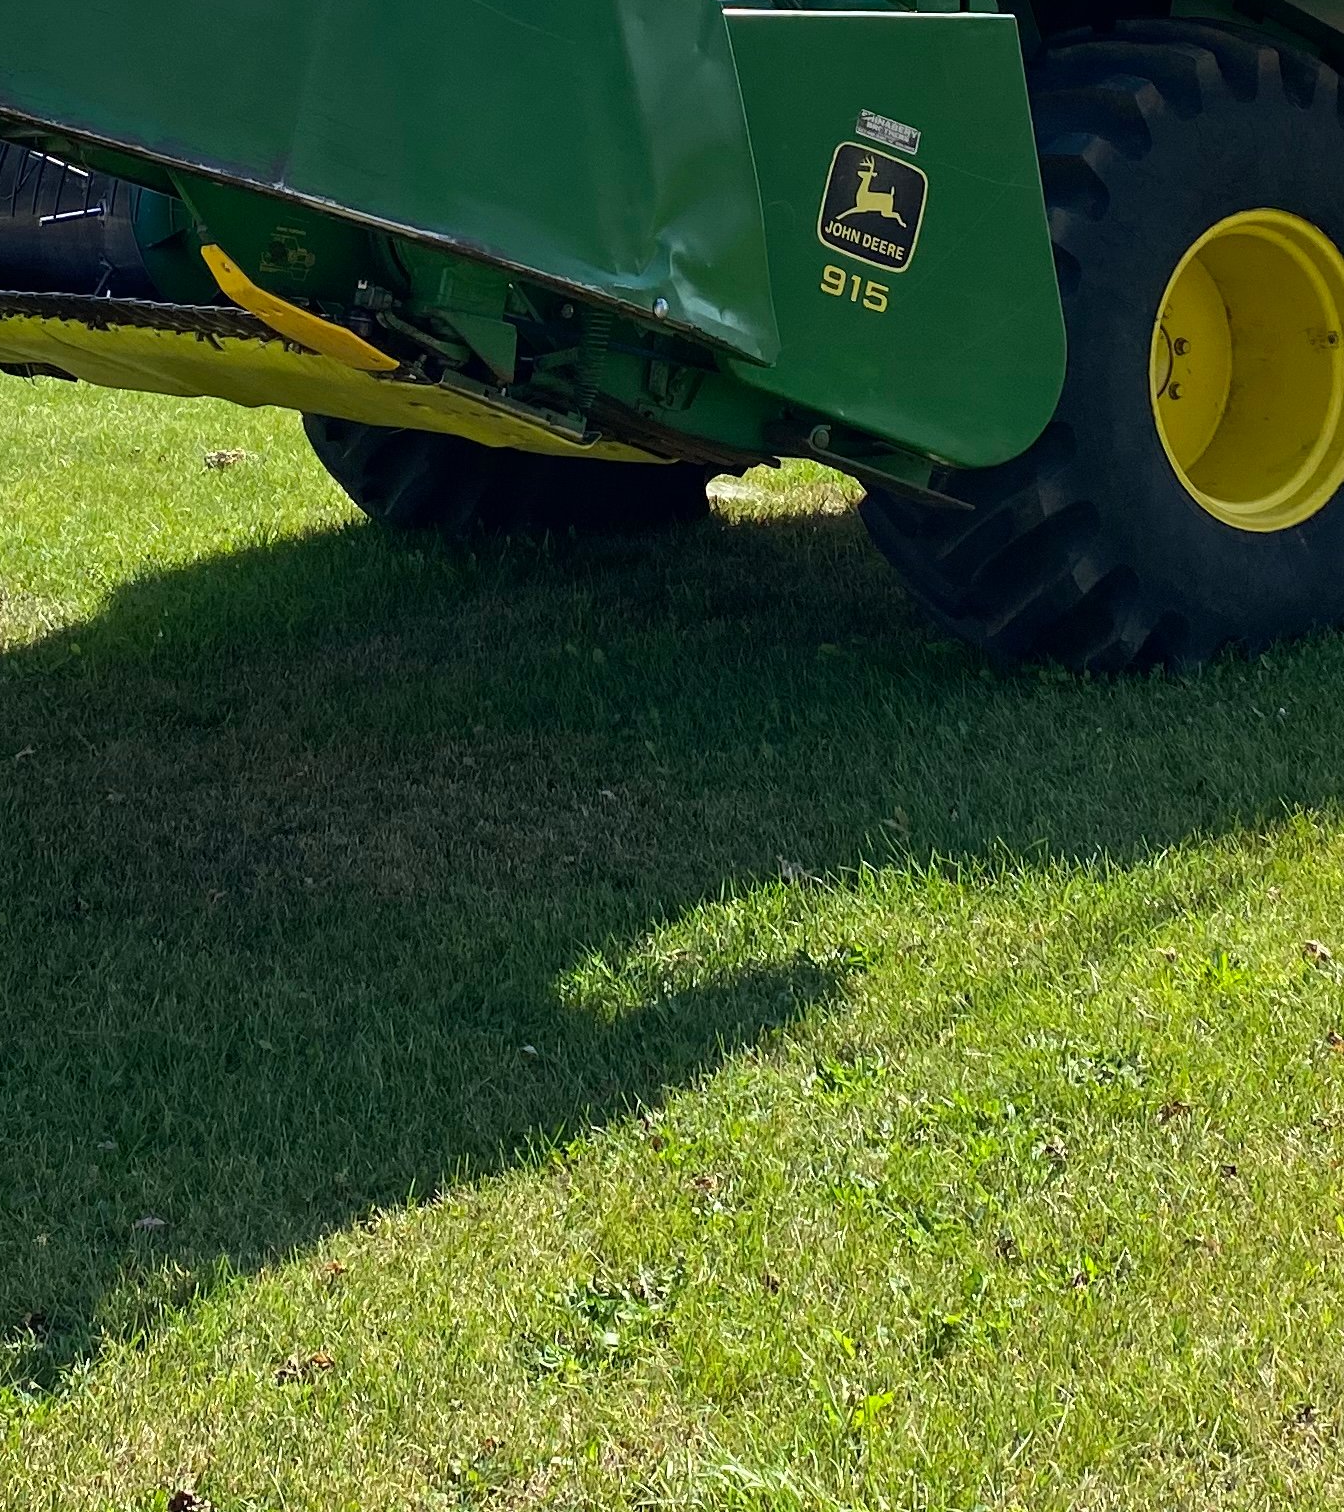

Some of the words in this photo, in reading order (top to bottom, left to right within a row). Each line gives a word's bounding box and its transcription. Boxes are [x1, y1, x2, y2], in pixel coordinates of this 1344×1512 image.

[824, 220, 861, 244] JOHN
[862, 233, 905, 261] DEERE
[820, 264, 889, 313] 915
